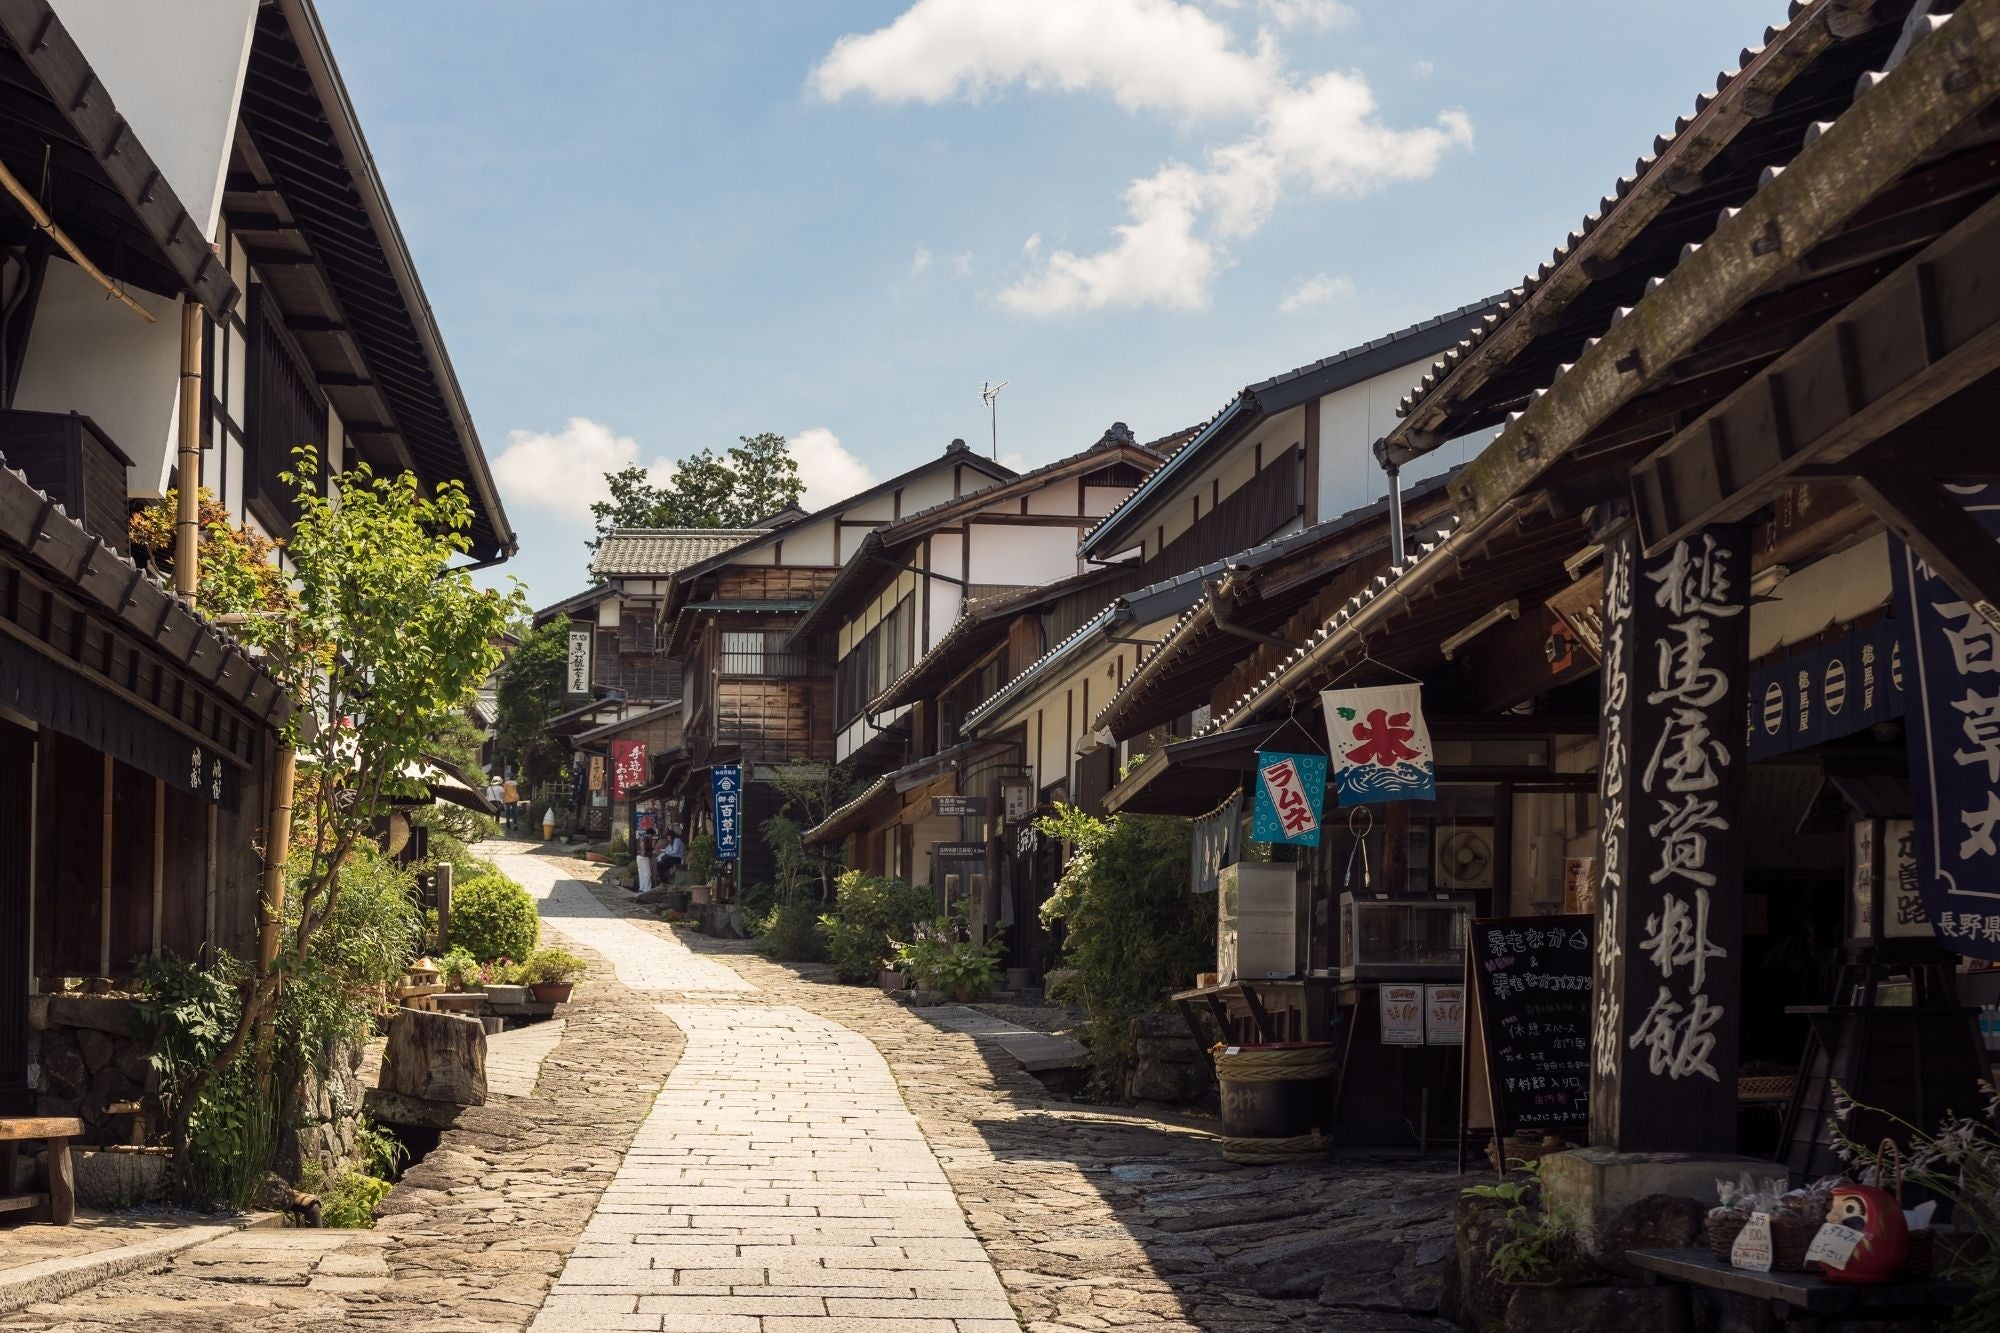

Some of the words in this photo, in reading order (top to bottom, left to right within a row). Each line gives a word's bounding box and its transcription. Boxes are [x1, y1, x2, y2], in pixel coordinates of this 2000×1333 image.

[1345, 709, 1422, 766] 氷
[1267, 764, 1311, 831] ラムネ
[720, 804, 735, 846] 百草丸
[1487, 928, 1566, 956] 栗もなか
[1937, 911, 2000, 943] 長野県
